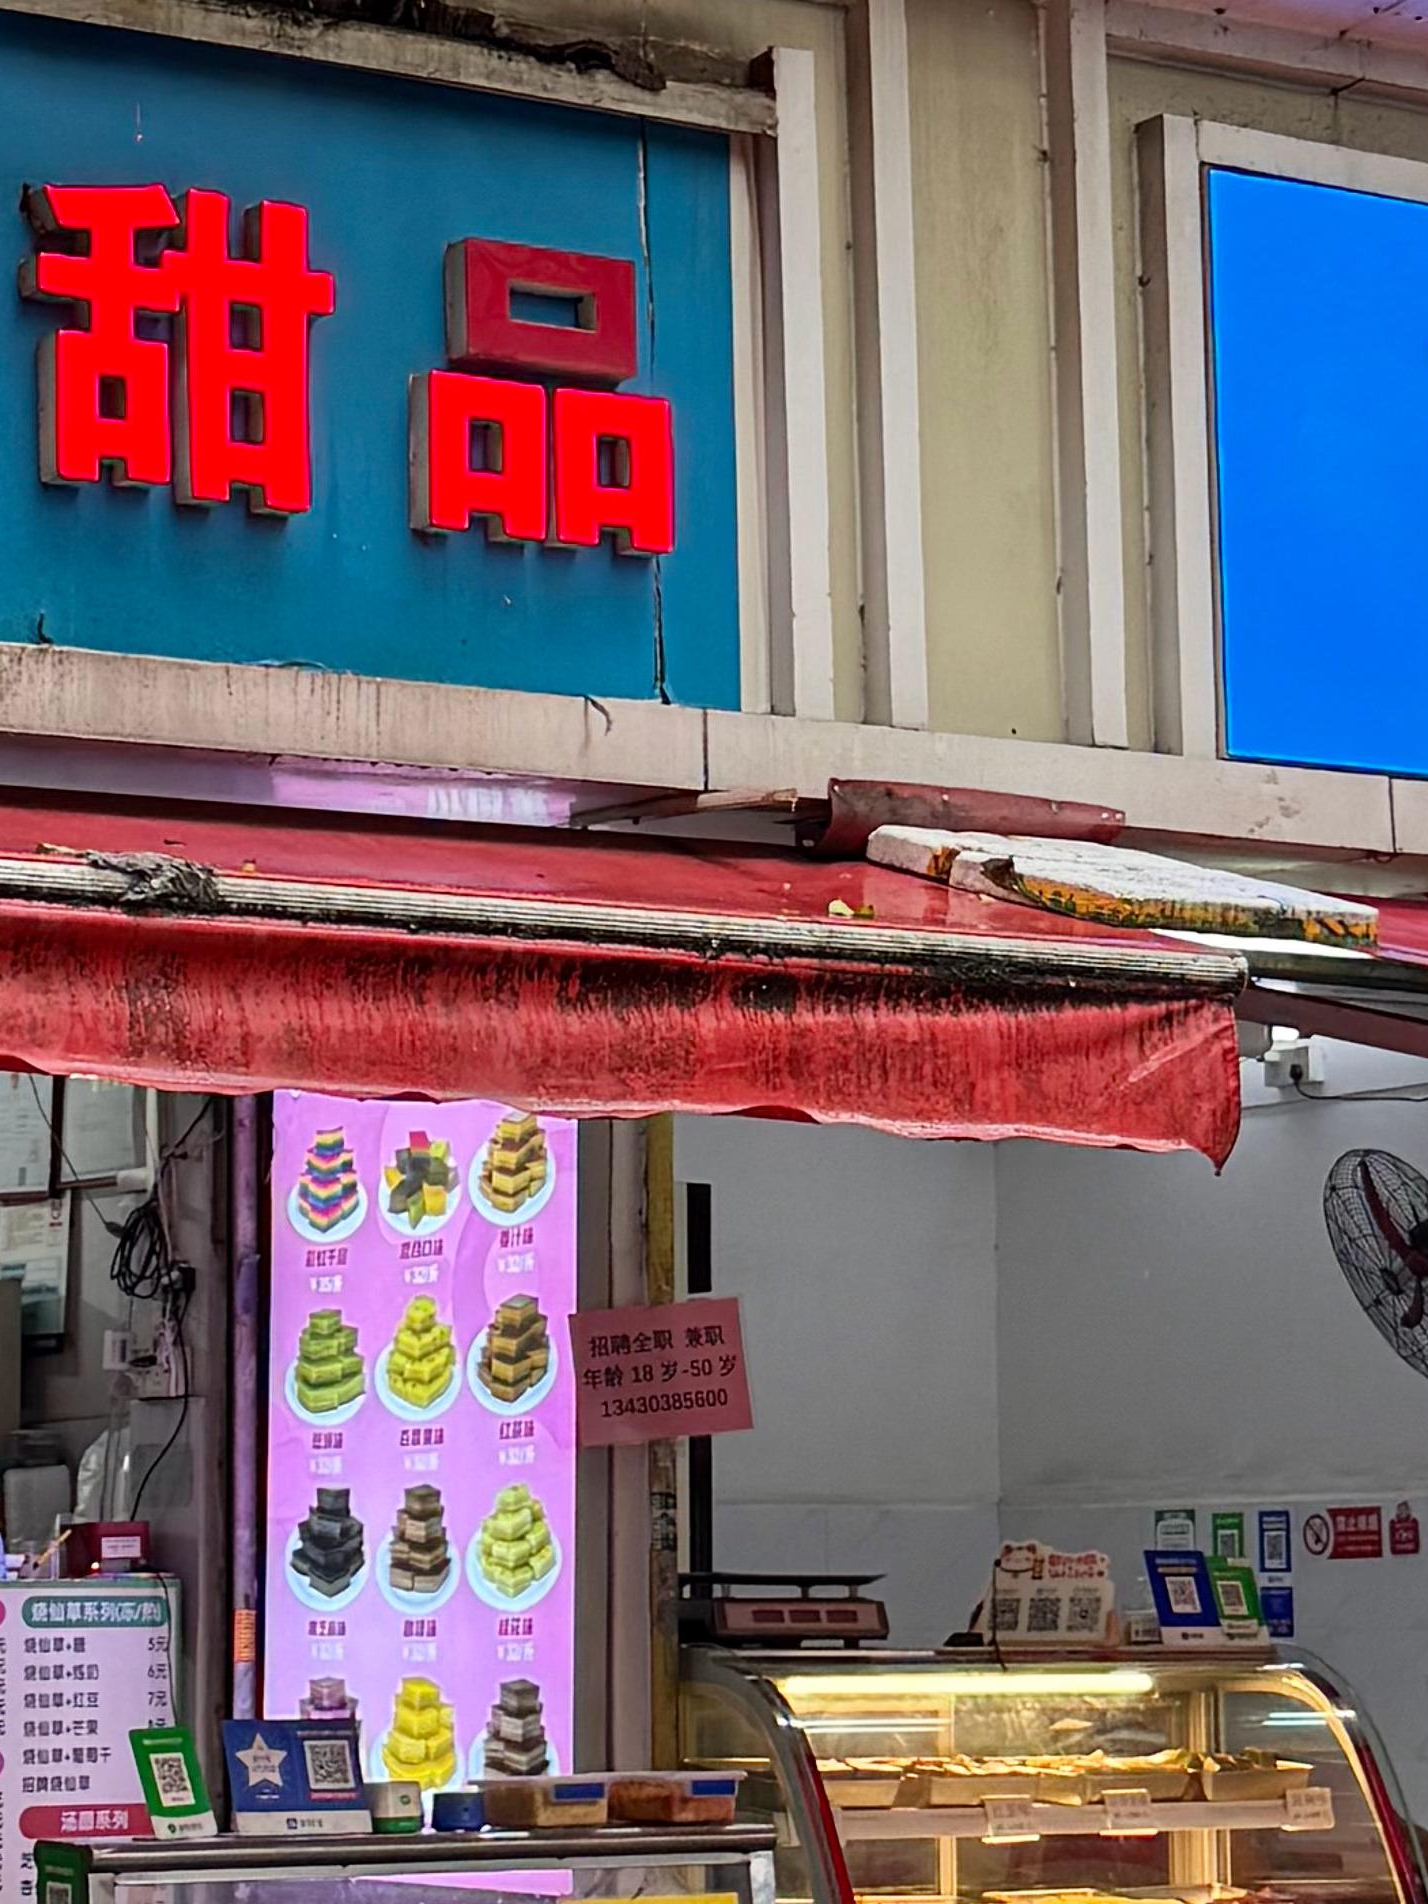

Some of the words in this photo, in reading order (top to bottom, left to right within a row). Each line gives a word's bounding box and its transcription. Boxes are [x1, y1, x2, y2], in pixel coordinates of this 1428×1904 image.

[588, 1327, 673, 1360] 招聘全职
[685, 1325, 725, 1348] 兼职
[582, 1364, 624, 1389] 年龄
[631, 1363, 654, 1384] 18
[717, 1352, 738, 1377] 岁
[601, 1388, 729, 1418] 13430385600
